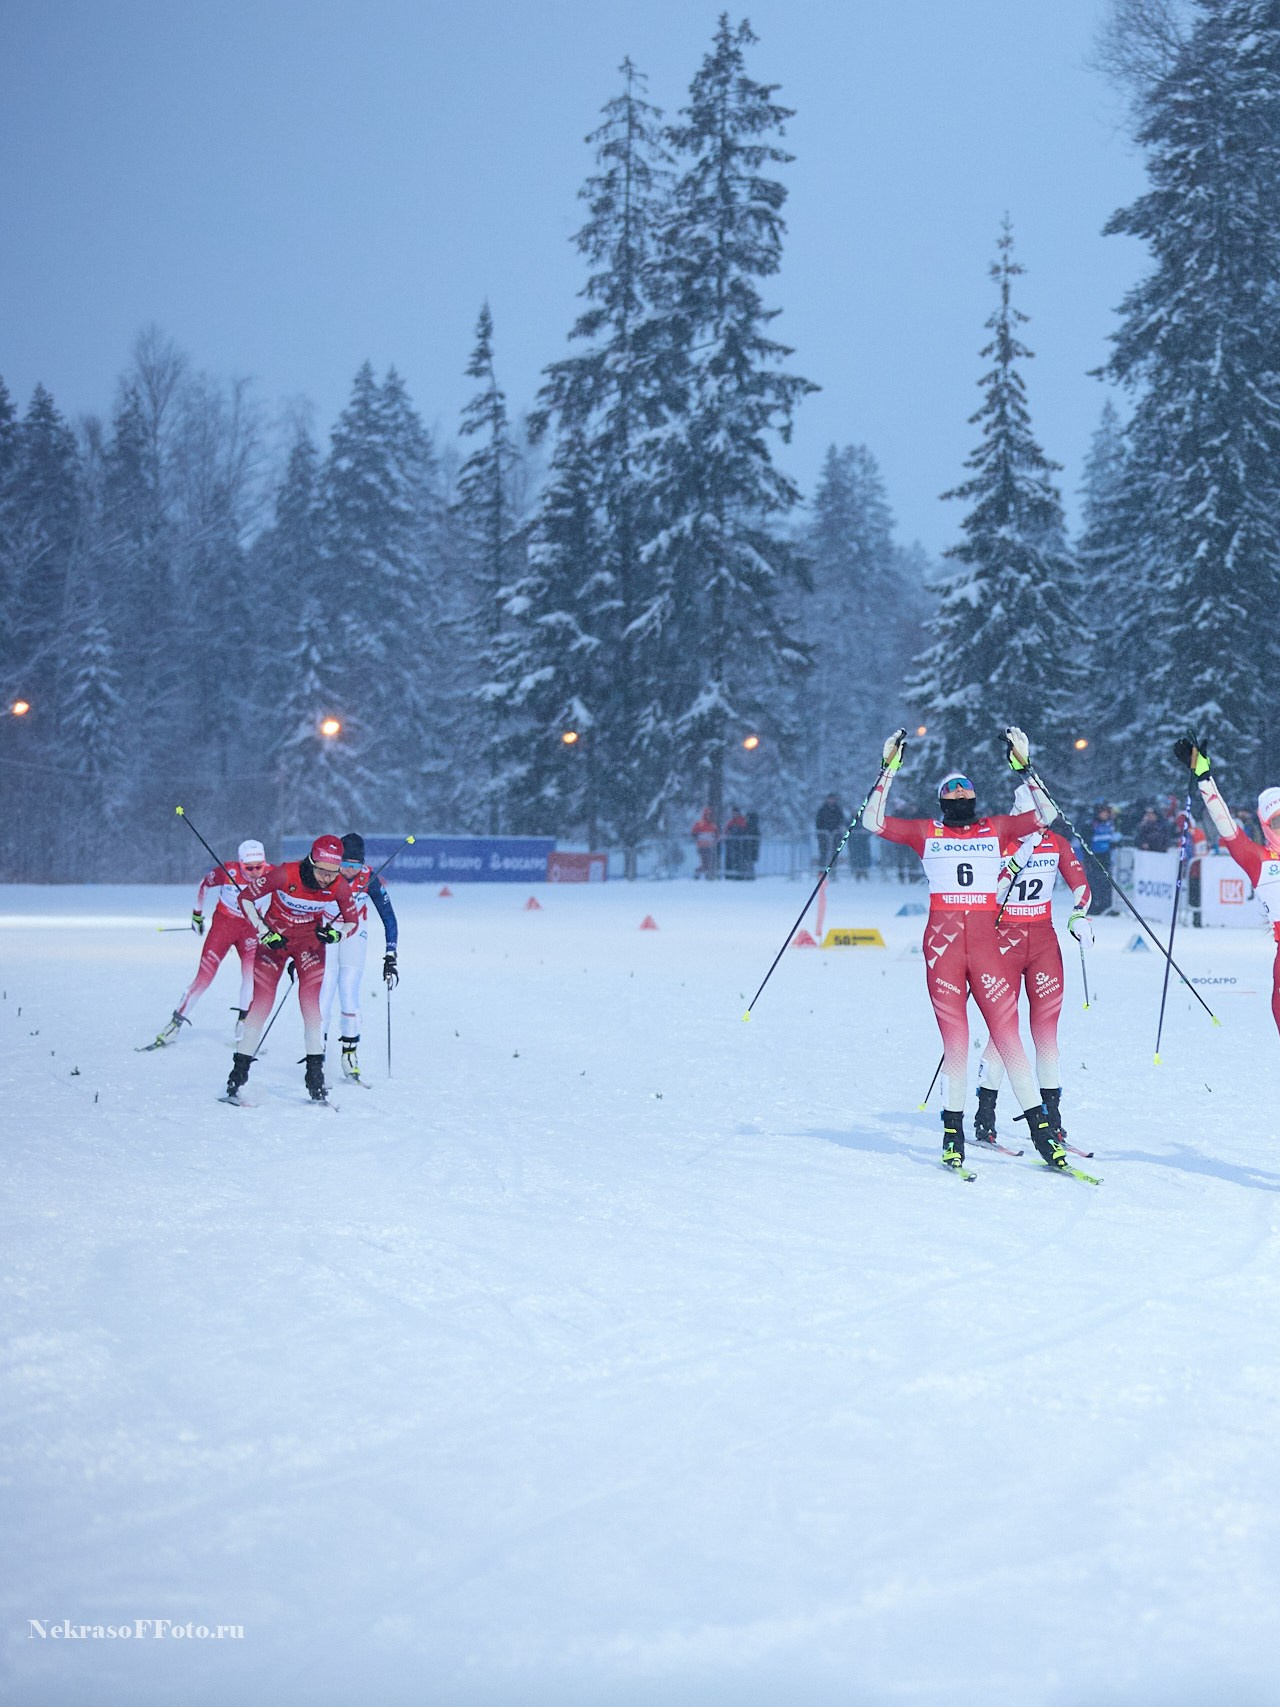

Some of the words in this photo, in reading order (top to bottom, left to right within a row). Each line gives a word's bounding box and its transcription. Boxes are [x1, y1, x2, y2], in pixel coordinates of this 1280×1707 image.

[944, 843, 994, 852] ФОСАГРО
[1026, 859, 1057, 869] САГРО
[957, 863, 974, 887] 6
[1015, 879, 1044, 902] 12
[942, 894, 987, 906] ЧЕПЕЦКОЕ
[1006, 904, 1047, 916] ЧЕПЕЦКОЕ
[1191, 977, 1237, 985] ФОСАГРО
